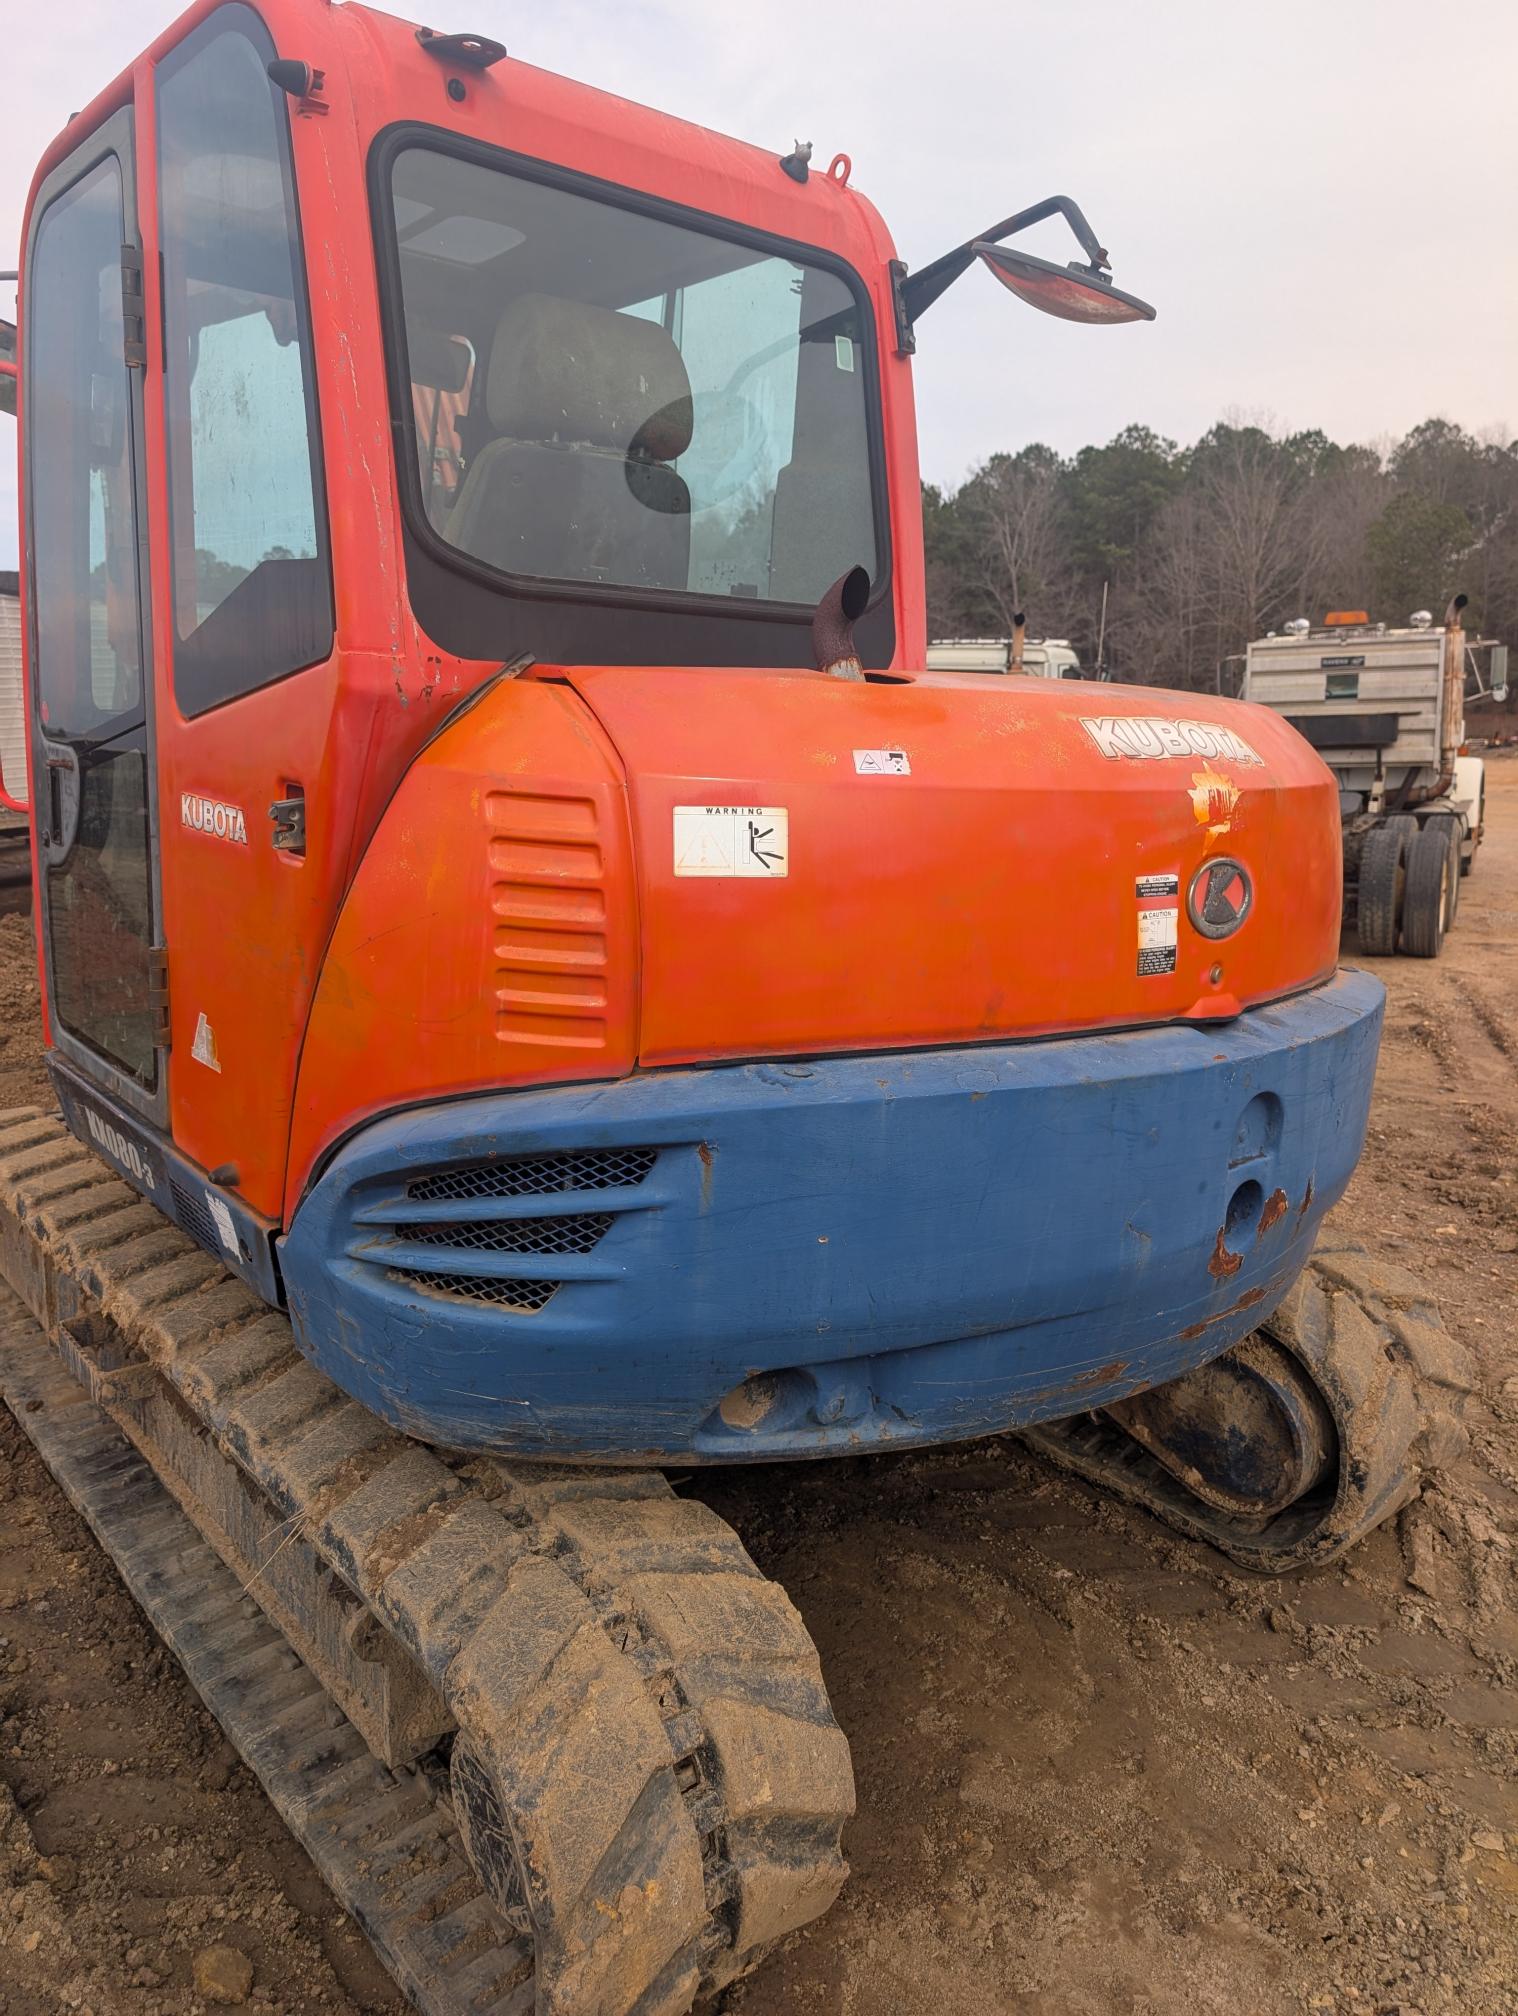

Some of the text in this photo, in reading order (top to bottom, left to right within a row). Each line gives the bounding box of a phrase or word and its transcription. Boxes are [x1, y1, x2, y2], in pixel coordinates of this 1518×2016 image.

[1081, 717, 1264, 766] KUBOTA
[180, 792, 248, 846] KUBOTA
[705, 807, 764, 816] WARNING
